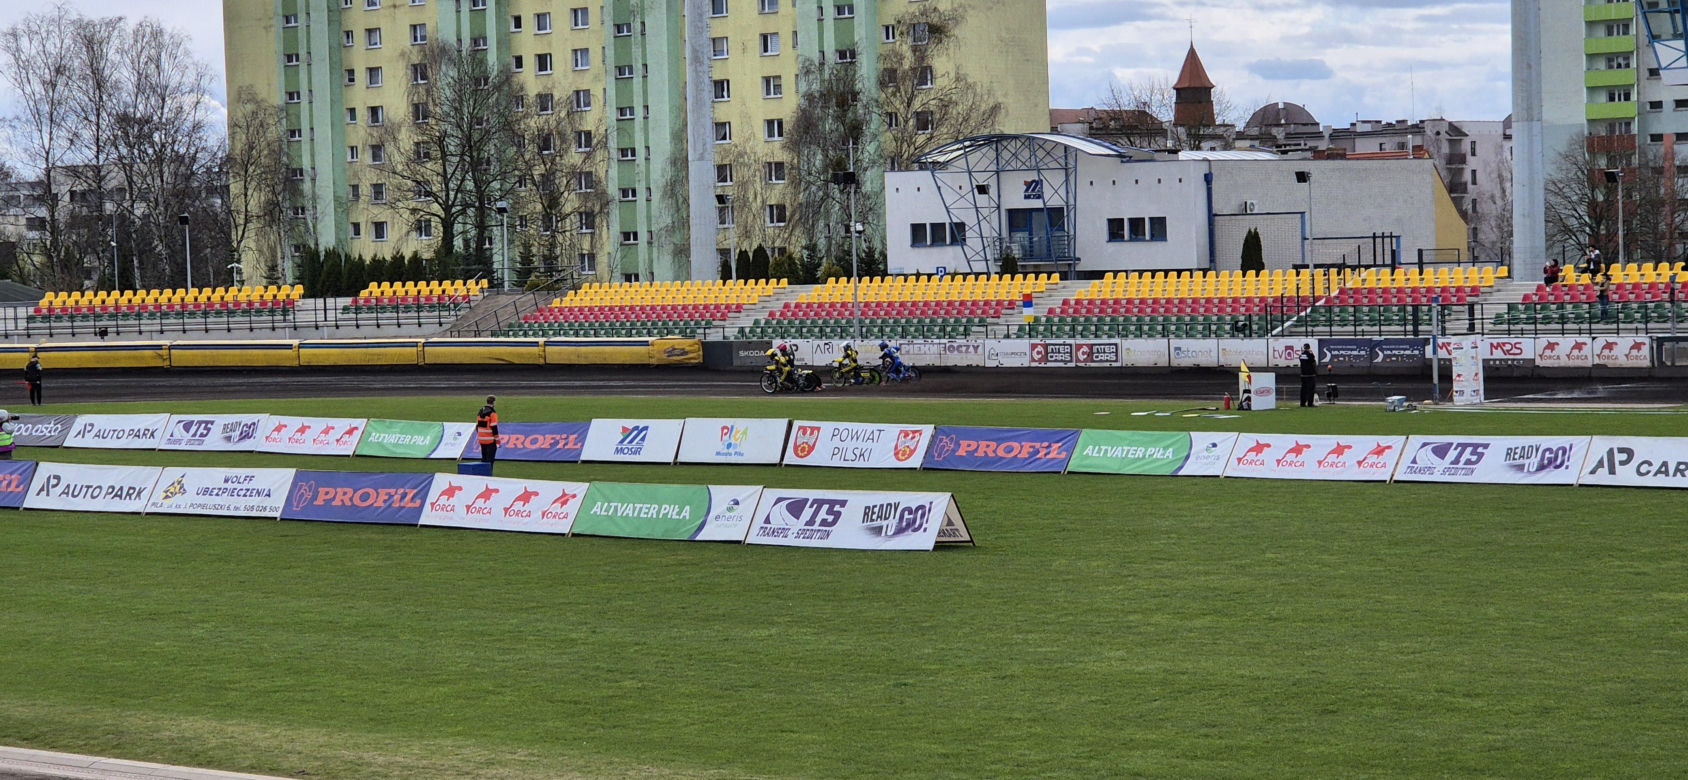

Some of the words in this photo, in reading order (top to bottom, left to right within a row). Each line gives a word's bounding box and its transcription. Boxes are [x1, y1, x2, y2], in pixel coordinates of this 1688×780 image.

[938, 268, 946, 276] P
[947, 344, 980, 354] OCZY
[92, 428, 124, 440] AUTO
[126, 428, 158, 440] PARK
[190, 420, 216, 438] TS
[222, 421, 242, 434] READY
[368, 432, 409, 444] ALTVATER
[830, 428, 886, 443] POWIAT
[830, 447, 873, 462] PILSKI
[1083, 445, 1145, 459] ALTVATER
[1448, 442, 1491, 466] TS
[1504, 444, 1542, 462] READY
[1540, 443, 1574, 470] GO!
[223, 475, 256, 484] WOLFF
[58, 484, 100, 500] AUTO
[102, 486, 147, 501] PARK
[196, 487, 272, 498] UBEZPIECZENIA
[434, 502, 455, 512] ORCA
[470, 506, 492, 516] ORCA
[509, 509, 532, 518] ORCA
[590, 502, 660, 518] ALTVATER
[804, 498, 848, 528] TS
[546, 511, 568, 520] ORCA
[714, 513, 744, 522] eneris
[862, 500, 900, 524] READY
[898, 501, 934, 533] GO!
[796, 528, 833, 541] SPEDITION
